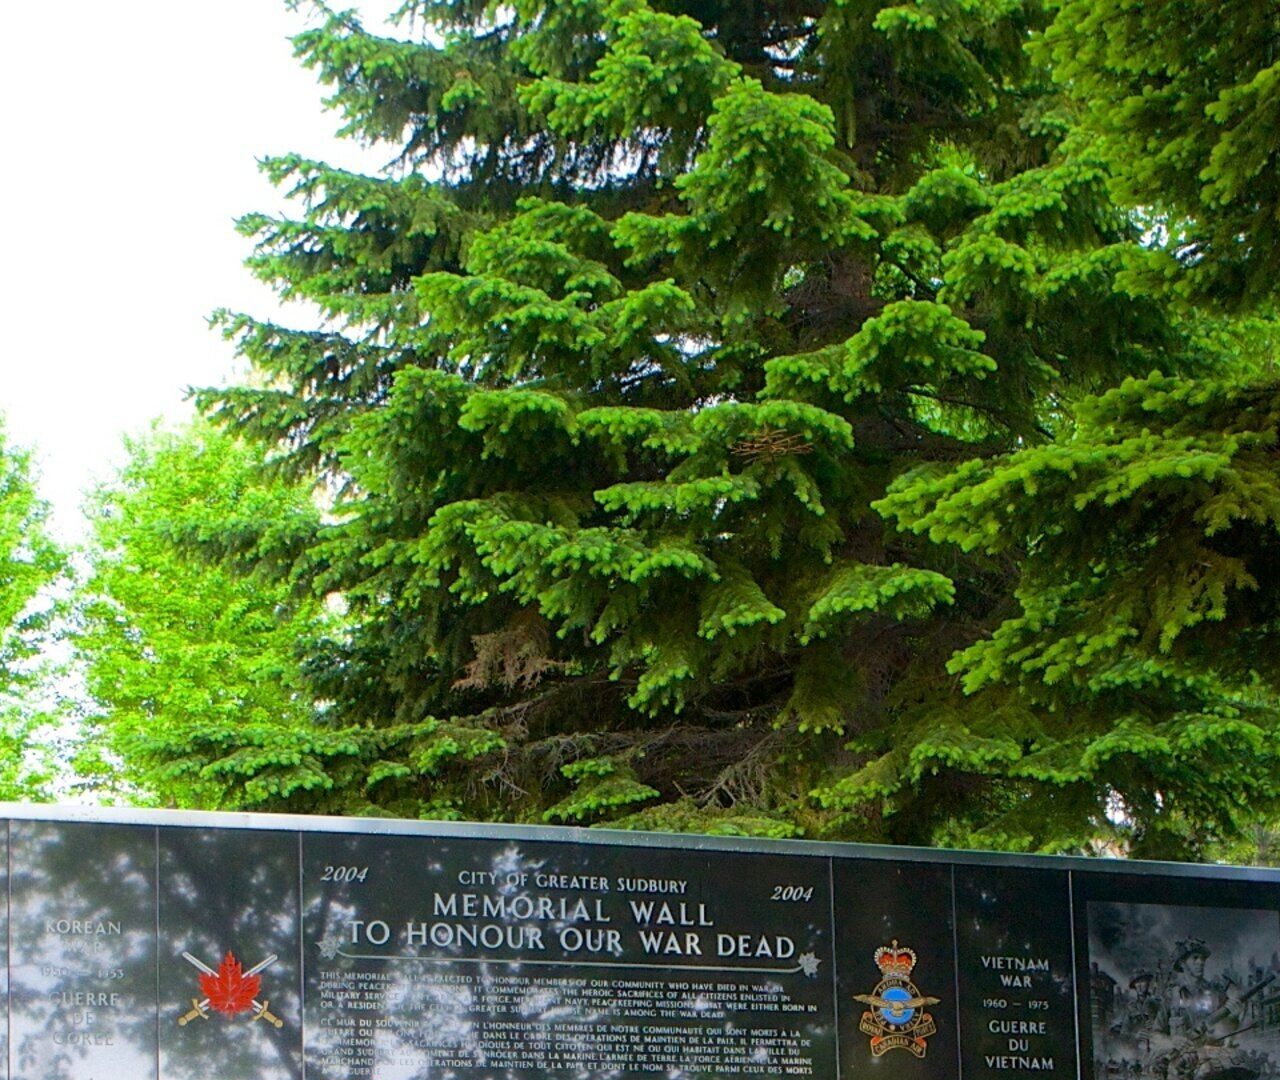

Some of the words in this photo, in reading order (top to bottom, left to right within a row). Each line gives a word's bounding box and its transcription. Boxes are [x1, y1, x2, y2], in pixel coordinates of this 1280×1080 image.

[320, 866, 369, 883] 2004
[458, 870, 497, 886] CITY
[506, 873, 529, 888] OF
[536, 874, 609, 891] GREATER
[616, 877, 687, 894] SUDBURY
[771, 886, 814, 902] 2004
[433, 893, 611, 923] MEMORIAL
[629, 900, 714, 927] WALL
[45, 919, 122, 935] KOREAN
[347, 920, 390, 945] TO
[407, 922, 545, 949] HONOUR
[559, 927, 624, 953] OUR
[638, 930, 703, 956] WAR
[717, 934, 795, 959] DEAD
[981, 956, 1049, 971] VIETNAM
[590, 980, 609, 988] OUR
[612, 981, 665, 989] COMMUNITY
[1000, 975, 1032, 988] WAR
[48, 992, 120, 1007] GUERRE
[983, 998, 1007, 1009] 1960
[1028, 999, 1049, 1010] 1975
[988, 1020, 1046, 1035] GUERRE
[1008, 1038, 1029, 1051] DU
[985, 1056, 1054, 1070] VIETNAM
